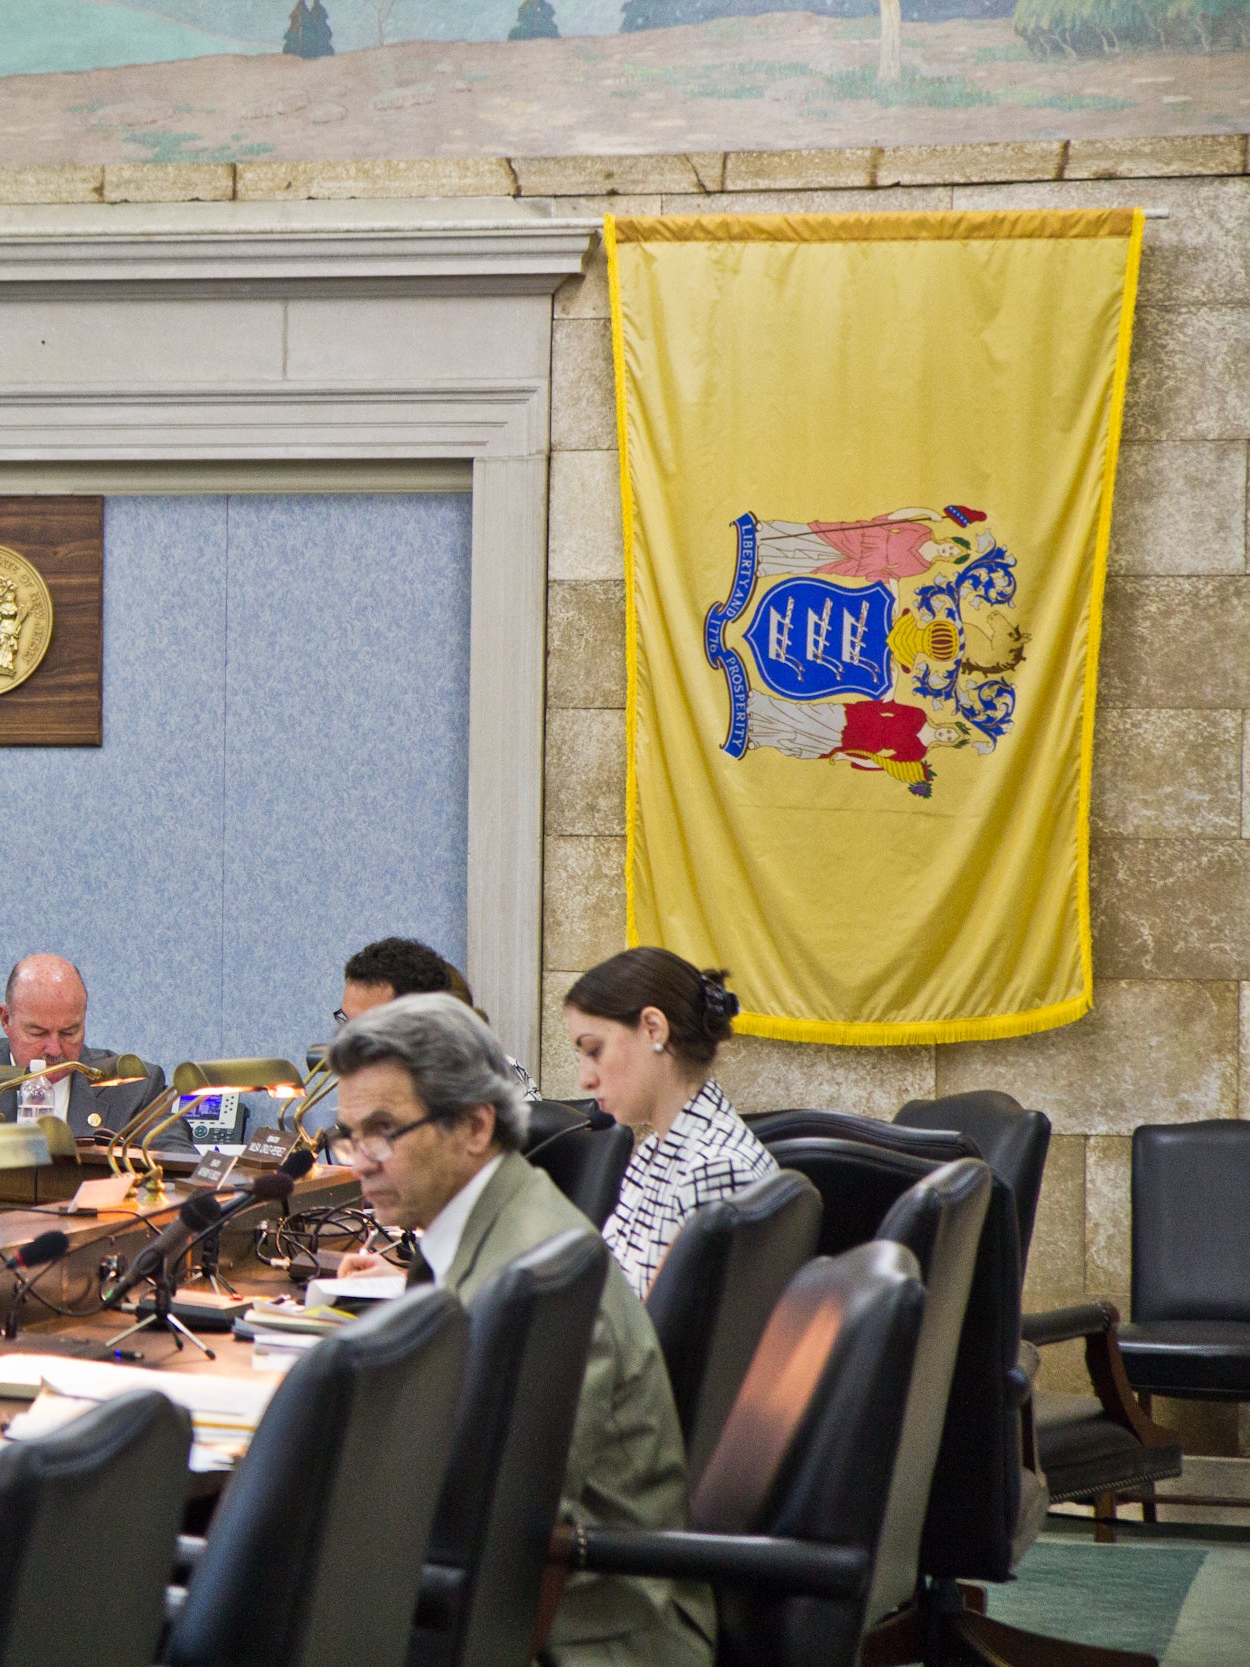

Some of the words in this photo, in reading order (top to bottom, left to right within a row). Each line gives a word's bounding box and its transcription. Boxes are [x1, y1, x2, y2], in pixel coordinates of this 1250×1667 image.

[739, 524, 753, 588] LIBERTY
[726, 588, 745, 617] AND
[709, 619, 721, 653] 1776
[725, 656, 747, 748] PROSPERITY
